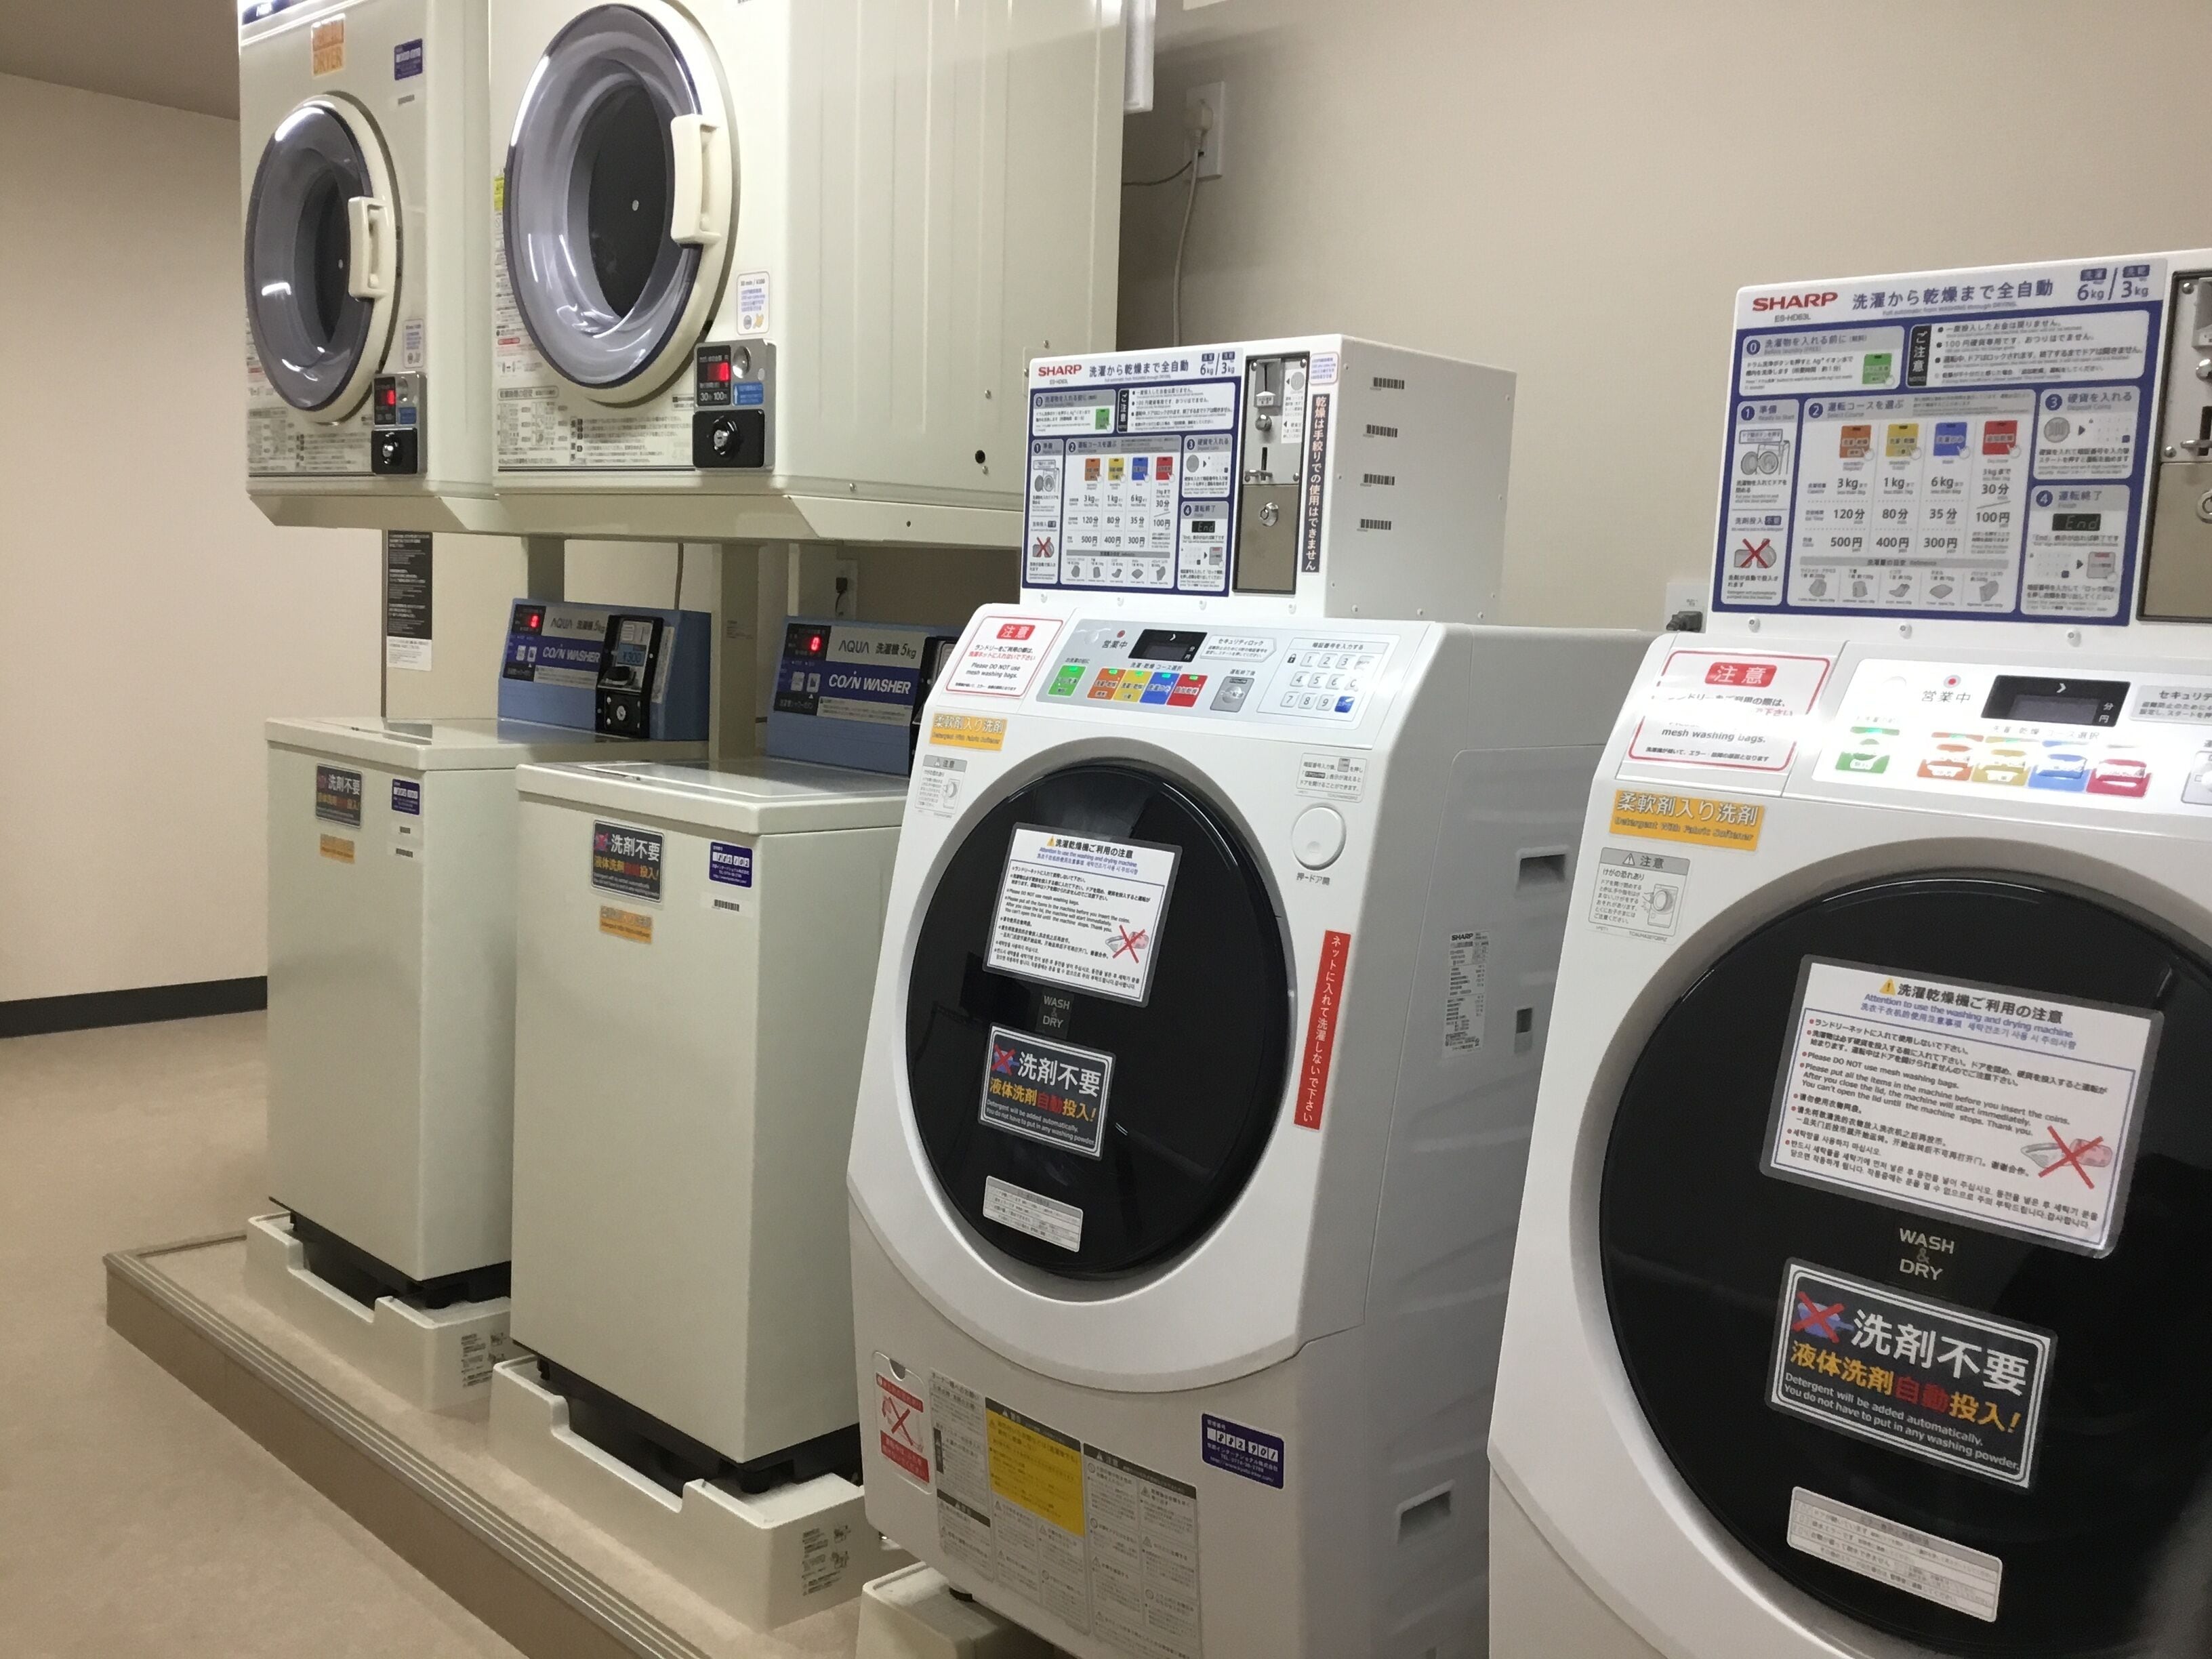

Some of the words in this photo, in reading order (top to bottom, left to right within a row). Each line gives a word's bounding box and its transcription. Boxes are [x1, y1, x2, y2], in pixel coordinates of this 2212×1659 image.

[1851, 278, 2053, 310] 洗濯から乾燥まで全自動
[1752, 291, 1838, 312] SHARP
[1912, 331, 1926, 373] ご注意
[1038, 364, 1082, 376] SHARP
[1089, 360, 1189, 377] 洗濯から乾燥まで全自動
[2067, 392, 2132, 403] 硬貨を入れる
[1828, 399, 1904, 412] 運転コースを選ぶ
[1305, 396, 1327, 571] 乾燥は手絞りでの使用はできません
[1981, 483, 2009, 495] 30分
[2058, 491, 2102, 501] 運転終了
[1082, 516, 1099, 524] 120分
[1107, 516, 1120, 525] 80分
[1130, 516, 1144, 525] 35分
[1832, 508, 1864, 520] 120分
[1882, 508, 1908, 520] 80分
[1929, 508, 1958, 520] 35分
[1975, 512, 2010, 523] 100円
[1081, 535, 1098, 544] 500円
[1128, 536, 1145, 544] 300円
[1830, 536, 1862, 548] 500円
[1875, 537, 1909, 549] 400円
[1923, 537, 1958, 549] 300円
[1002, 626, 1029, 638] 注意
[1101, 639, 1129, 649] 営業中
[567, 649, 600, 663] WASHER
[1714, 665, 1767, 684] 注意
[863, 678, 912, 695] WASHER
[1921, 691, 1971, 703] 営業中
[2103, 702, 2114, 710] 分
[2099, 715, 2110, 723] 円
[1662, 728, 1689, 738] mesh
[1692, 731, 1734, 742] washing
[328, 774, 360, 795] 洗剤不要
[1616, 790, 1759, 826] 柔軟剤入り洗剤
[611, 834, 660, 862] 洗剤不要
[1055, 838, 1134, 859] 洗濯乾燥機ご利用の注意
[1639, 855, 1664, 869] 注意
[1452, 933, 1473, 941] SHARP
[1043, 995, 1071, 1010] WASH
[1897, 983, 2064, 1025] 洗濯乾燥機ご利用の注意
[1042, 1015, 1064, 1029] DRY
[1864, 993, 1902, 1006] Attention
[1903, 1000, 1912, 1008] to
[1930, 1004, 1944, 1015] the
[1945, 1008, 1982, 1023] washing
[1984, 1015, 2001, 1024] and
[2002, 1017, 2032, 1031] drying
[2034, 1023, 2073, 1038] machine
[1303, 935, 1341, 1122] ネットに入れて洗濯しないで下さい
[1017, 1050, 1101, 1099] 洗剤不要
[1807, 1052, 1831, 1062] Please
[1832, 1057, 1844, 1065] DO
[1846, 1059, 1862, 1068] NOT
[1879, 1066, 1900, 1076] mesh
[1902, 1071, 1936, 1086] washing
[1937, 1078, 1959, 1090] bags.
[1803, 1071, 1822, 1080] After
[1823, 1077, 1837, 1085] you
[1839, 1078, 1858, 1088] close
[1860, 1083, 1872, 1092] the
[1874, 1086, 1886, 1096] lid,
[1888, 1088, 1902, 1098] the
[1903, 1092, 1938, 1105] machine
[1939, 1099, 1953, 1109] will
[1955, 1103, 1975, 1113] start
[1977, 1107, 2030, 1126] immediately.
[1805, 1063, 1828, 1073] Please
[1830, 1068, 1843, 1078] put
[1845, 1071, 1853, 1079] all
[1855, 1073, 1868, 1082] the
[1870, 1076, 1892, 1086] items
[1903, 1083, 1916, 1092] the
[1918, 1086, 1952, 1099] machine
[1954, 1094, 1982, 1105] before
[1983, 1101, 1999, 1110] you
[2001, 1103, 2026, 1115] insert
[2028, 1109, 2043, 1118] the
[2045, 1113, 2070, 1124] coins.
[1801, 1080, 1815, 1088] You
[1817, 1083, 1835, 1092] can't
[1836, 1088, 1855, 1098] open
[1857, 1092, 1870, 1100] the
[1872, 1094, 1881, 1103] lid
[1883, 1097, 1901, 1107] until
[1905, 1102, 1919, 1111] the
[1920, 1105, 1955, 1118] machine
[1959, 1113, 1984, 1126] stops.
[1986, 1120, 2013, 1131] Thank
[2015, 1127, 2032, 1136] you.
[1899, 1227, 1955, 1254] WASH
[1900, 1259, 1943, 1281] DRY
[1850, 1307, 2029, 1399] 洗剤不要
[1784, 1372, 1834, 1398] Detergent
[1836, 1389, 1854, 1404] will
[1856, 1395, 1870, 1408] be
[1871, 1400, 1904, 1420] added
[1906, 1412, 1984, 1448] automatically.
[1783, 1383, 1802, 1398] You
[1803, 1390, 1816, 1403] do
[1817, 1395, 1834, 1409] not
[1835, 1401, 1860, 1418] have
[1861, 1409, 1872, 1422] to
[1872, 1413, 1892, 1431] put
[1893, 1420, 1904, 1432] in
[1904, 1426, 1925, 1441] any
[1926, 1431, 1973, 1458] washing
[1974, 1447, 2020, 1473] powder.
